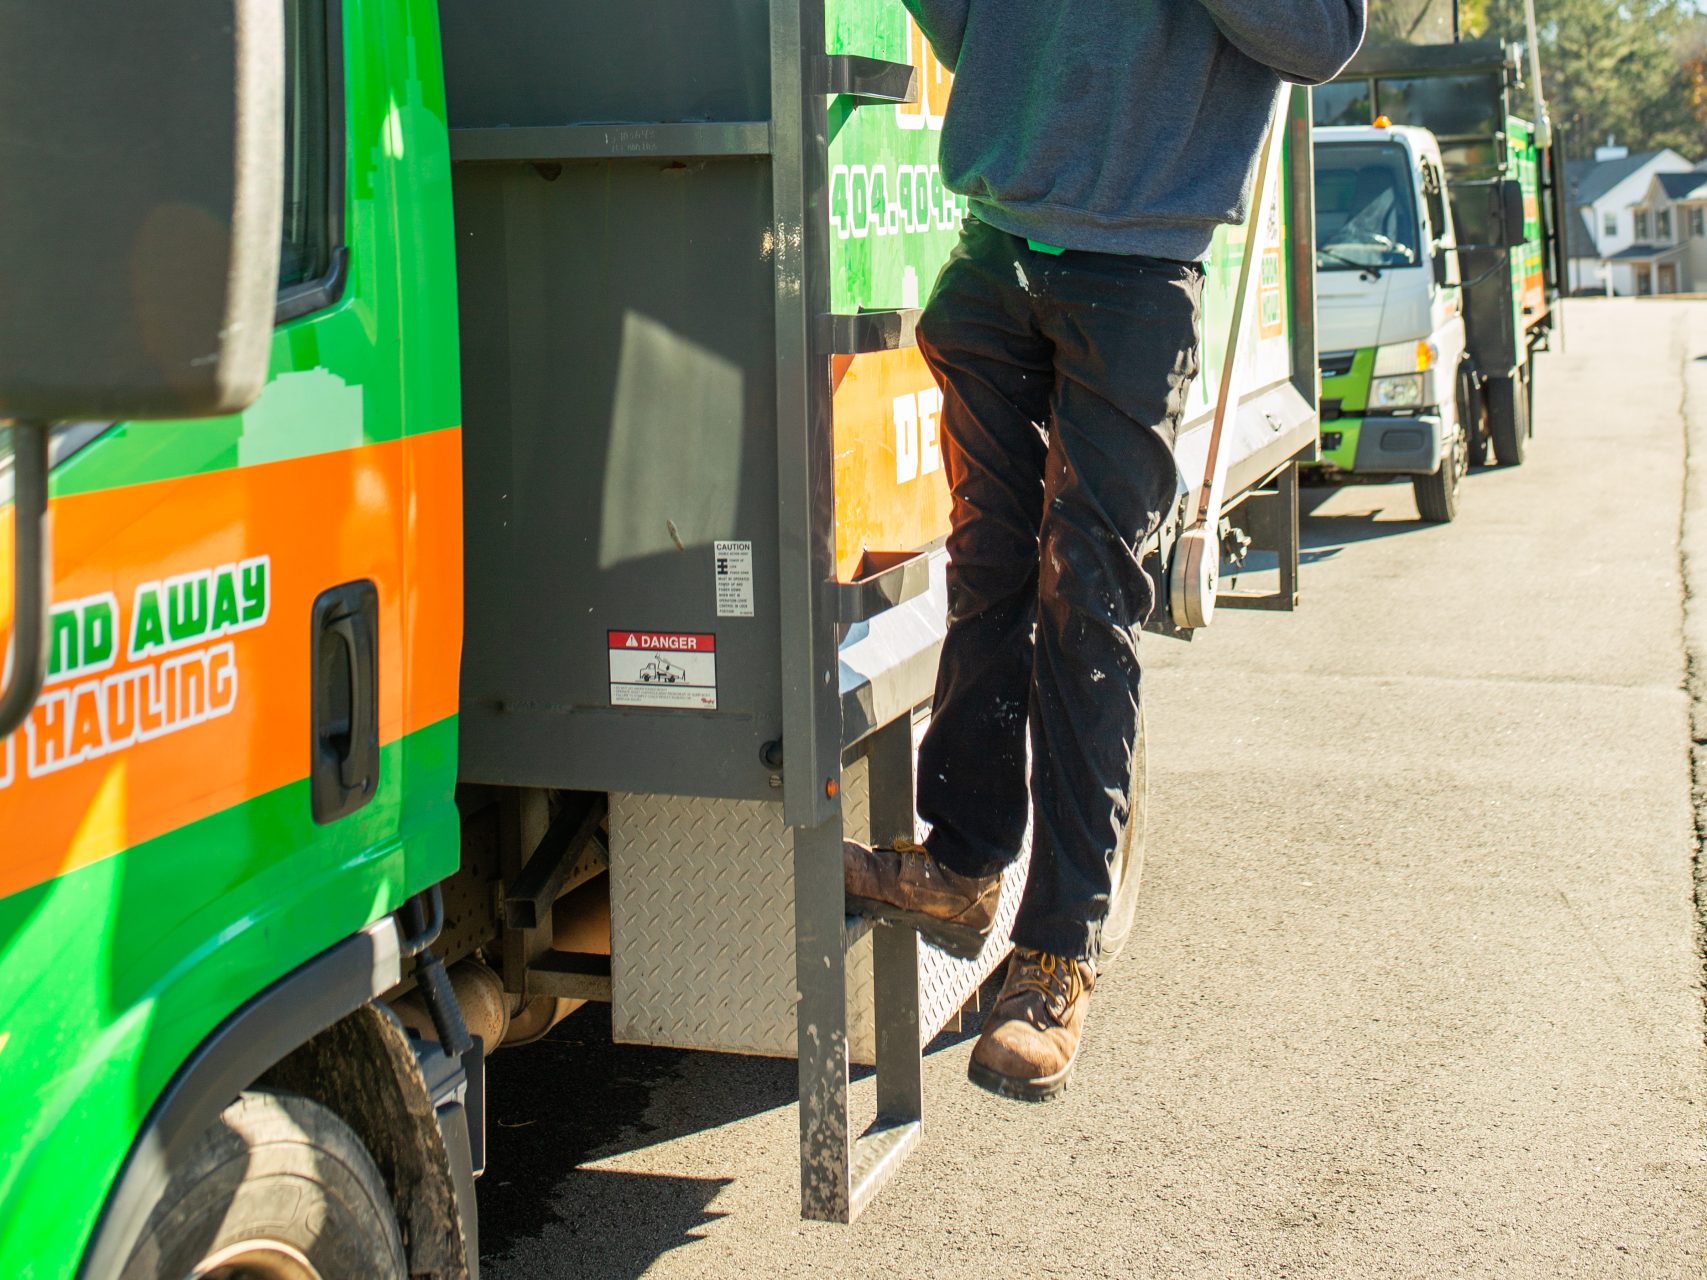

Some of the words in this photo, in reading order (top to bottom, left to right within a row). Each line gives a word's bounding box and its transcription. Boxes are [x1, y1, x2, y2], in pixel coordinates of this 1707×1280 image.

[893, 386, 944, 485] DE
[716, 543, 750, 551] CAUTION
[4, 591, 120, 690] ND
[127, 555, 271, 662] AWAY
[641, 635, 697, 650] DANGER
[25, 641, 238, 778] HAULING
